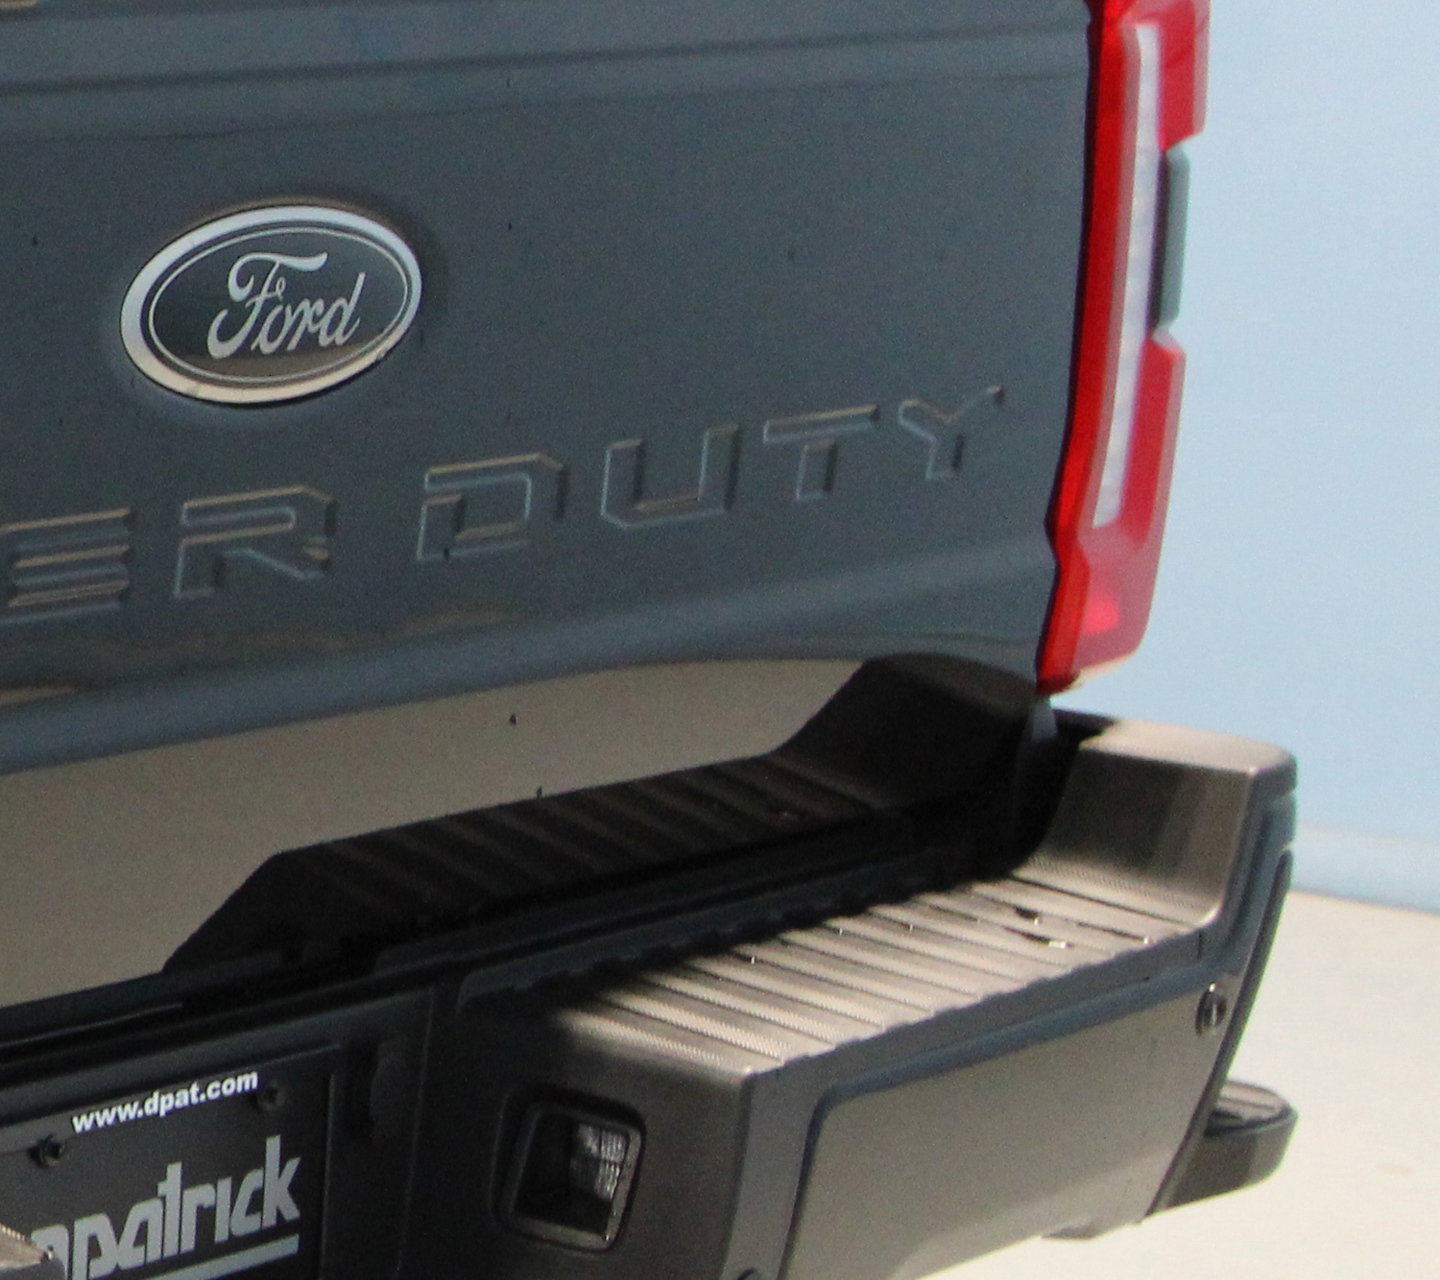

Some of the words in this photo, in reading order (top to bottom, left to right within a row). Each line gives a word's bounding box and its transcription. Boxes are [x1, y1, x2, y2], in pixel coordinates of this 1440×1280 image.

[207, 252, 366, 360] Ford
[417, 385, 1004, 562] DUTY
[72, 1072, 258, 1133] www.dpat.com
